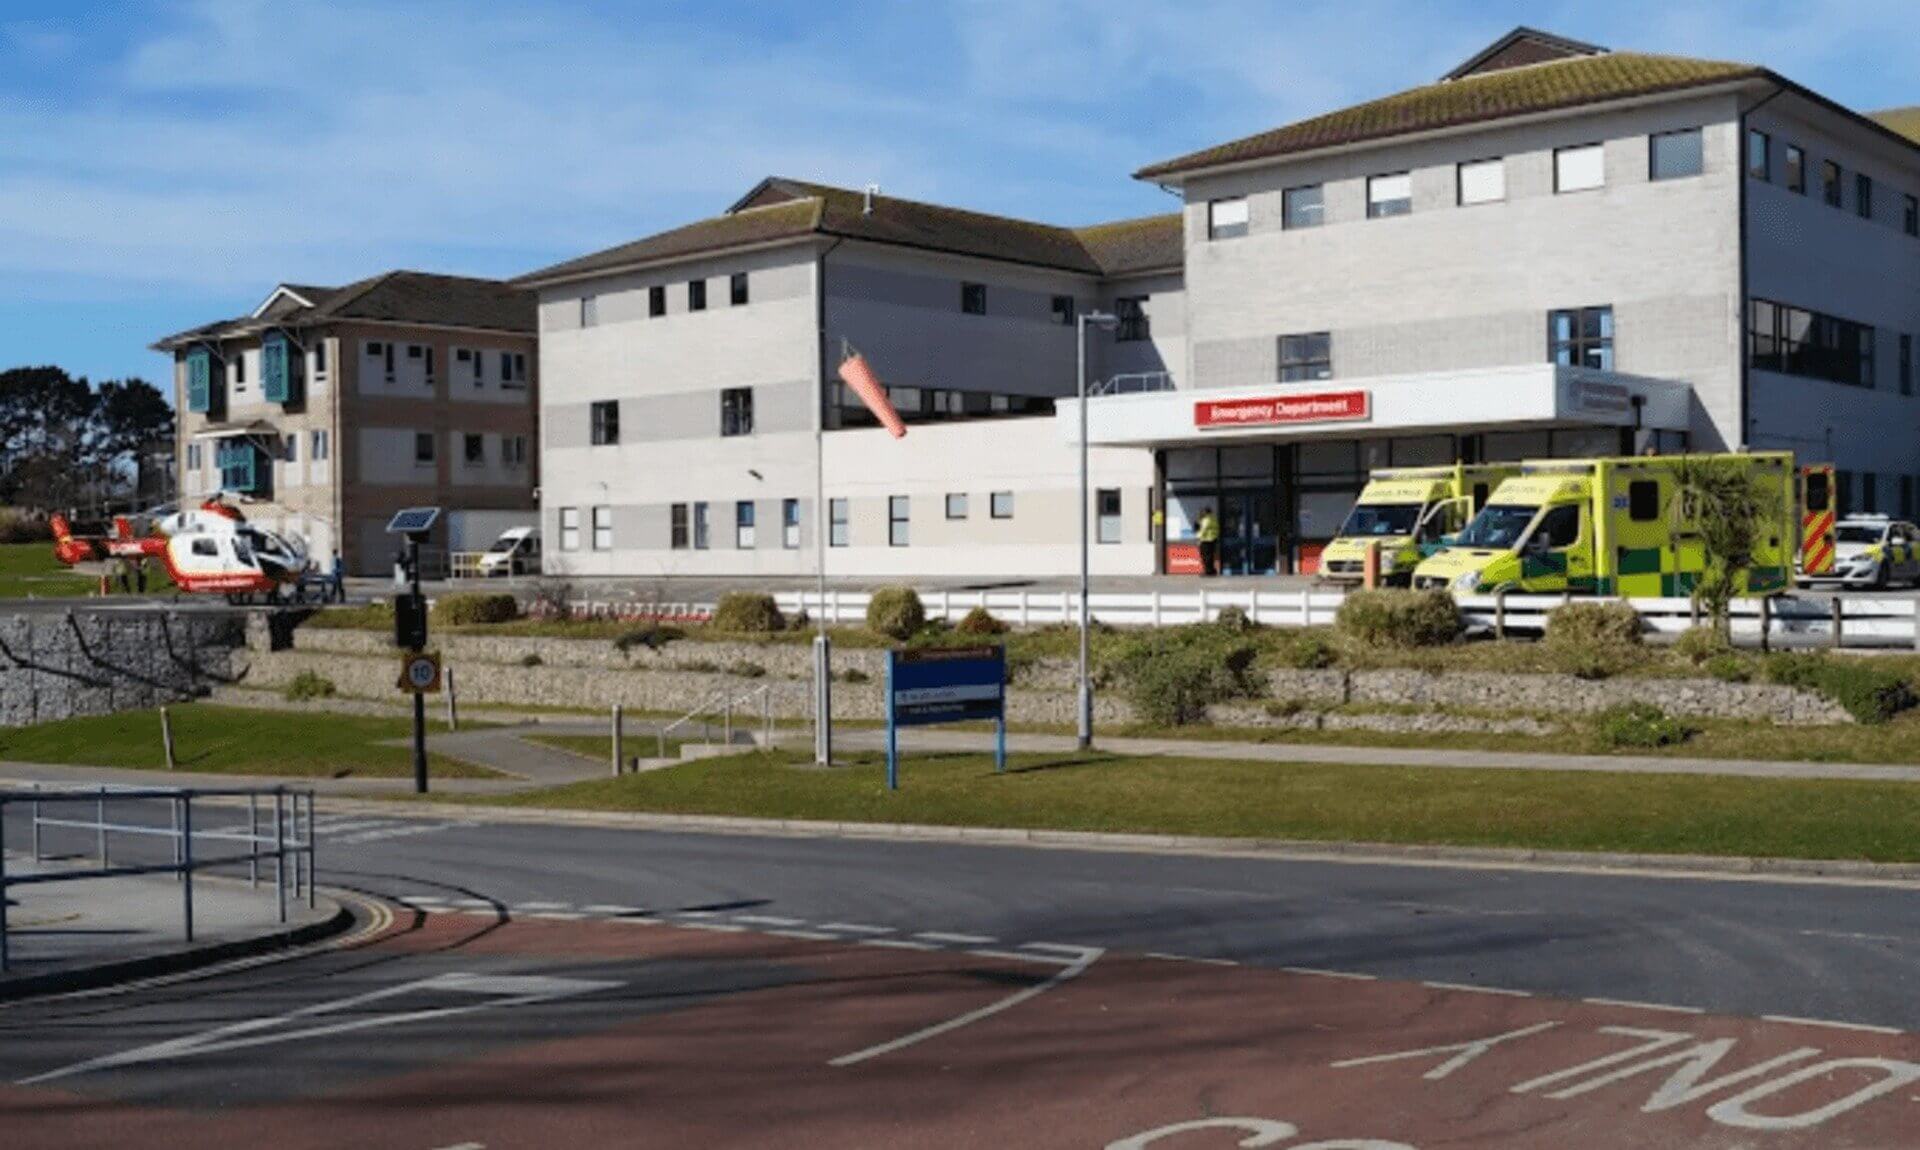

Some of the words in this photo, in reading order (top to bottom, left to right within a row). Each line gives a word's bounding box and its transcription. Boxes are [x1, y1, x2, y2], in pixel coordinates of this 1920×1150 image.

[1210, 404, 1274, 421] Emergency
[1276, 400, 1348, 416] Department
[413, 664, 430, 680] 10
[1331, 1021, 1920, 1129] ONLY
